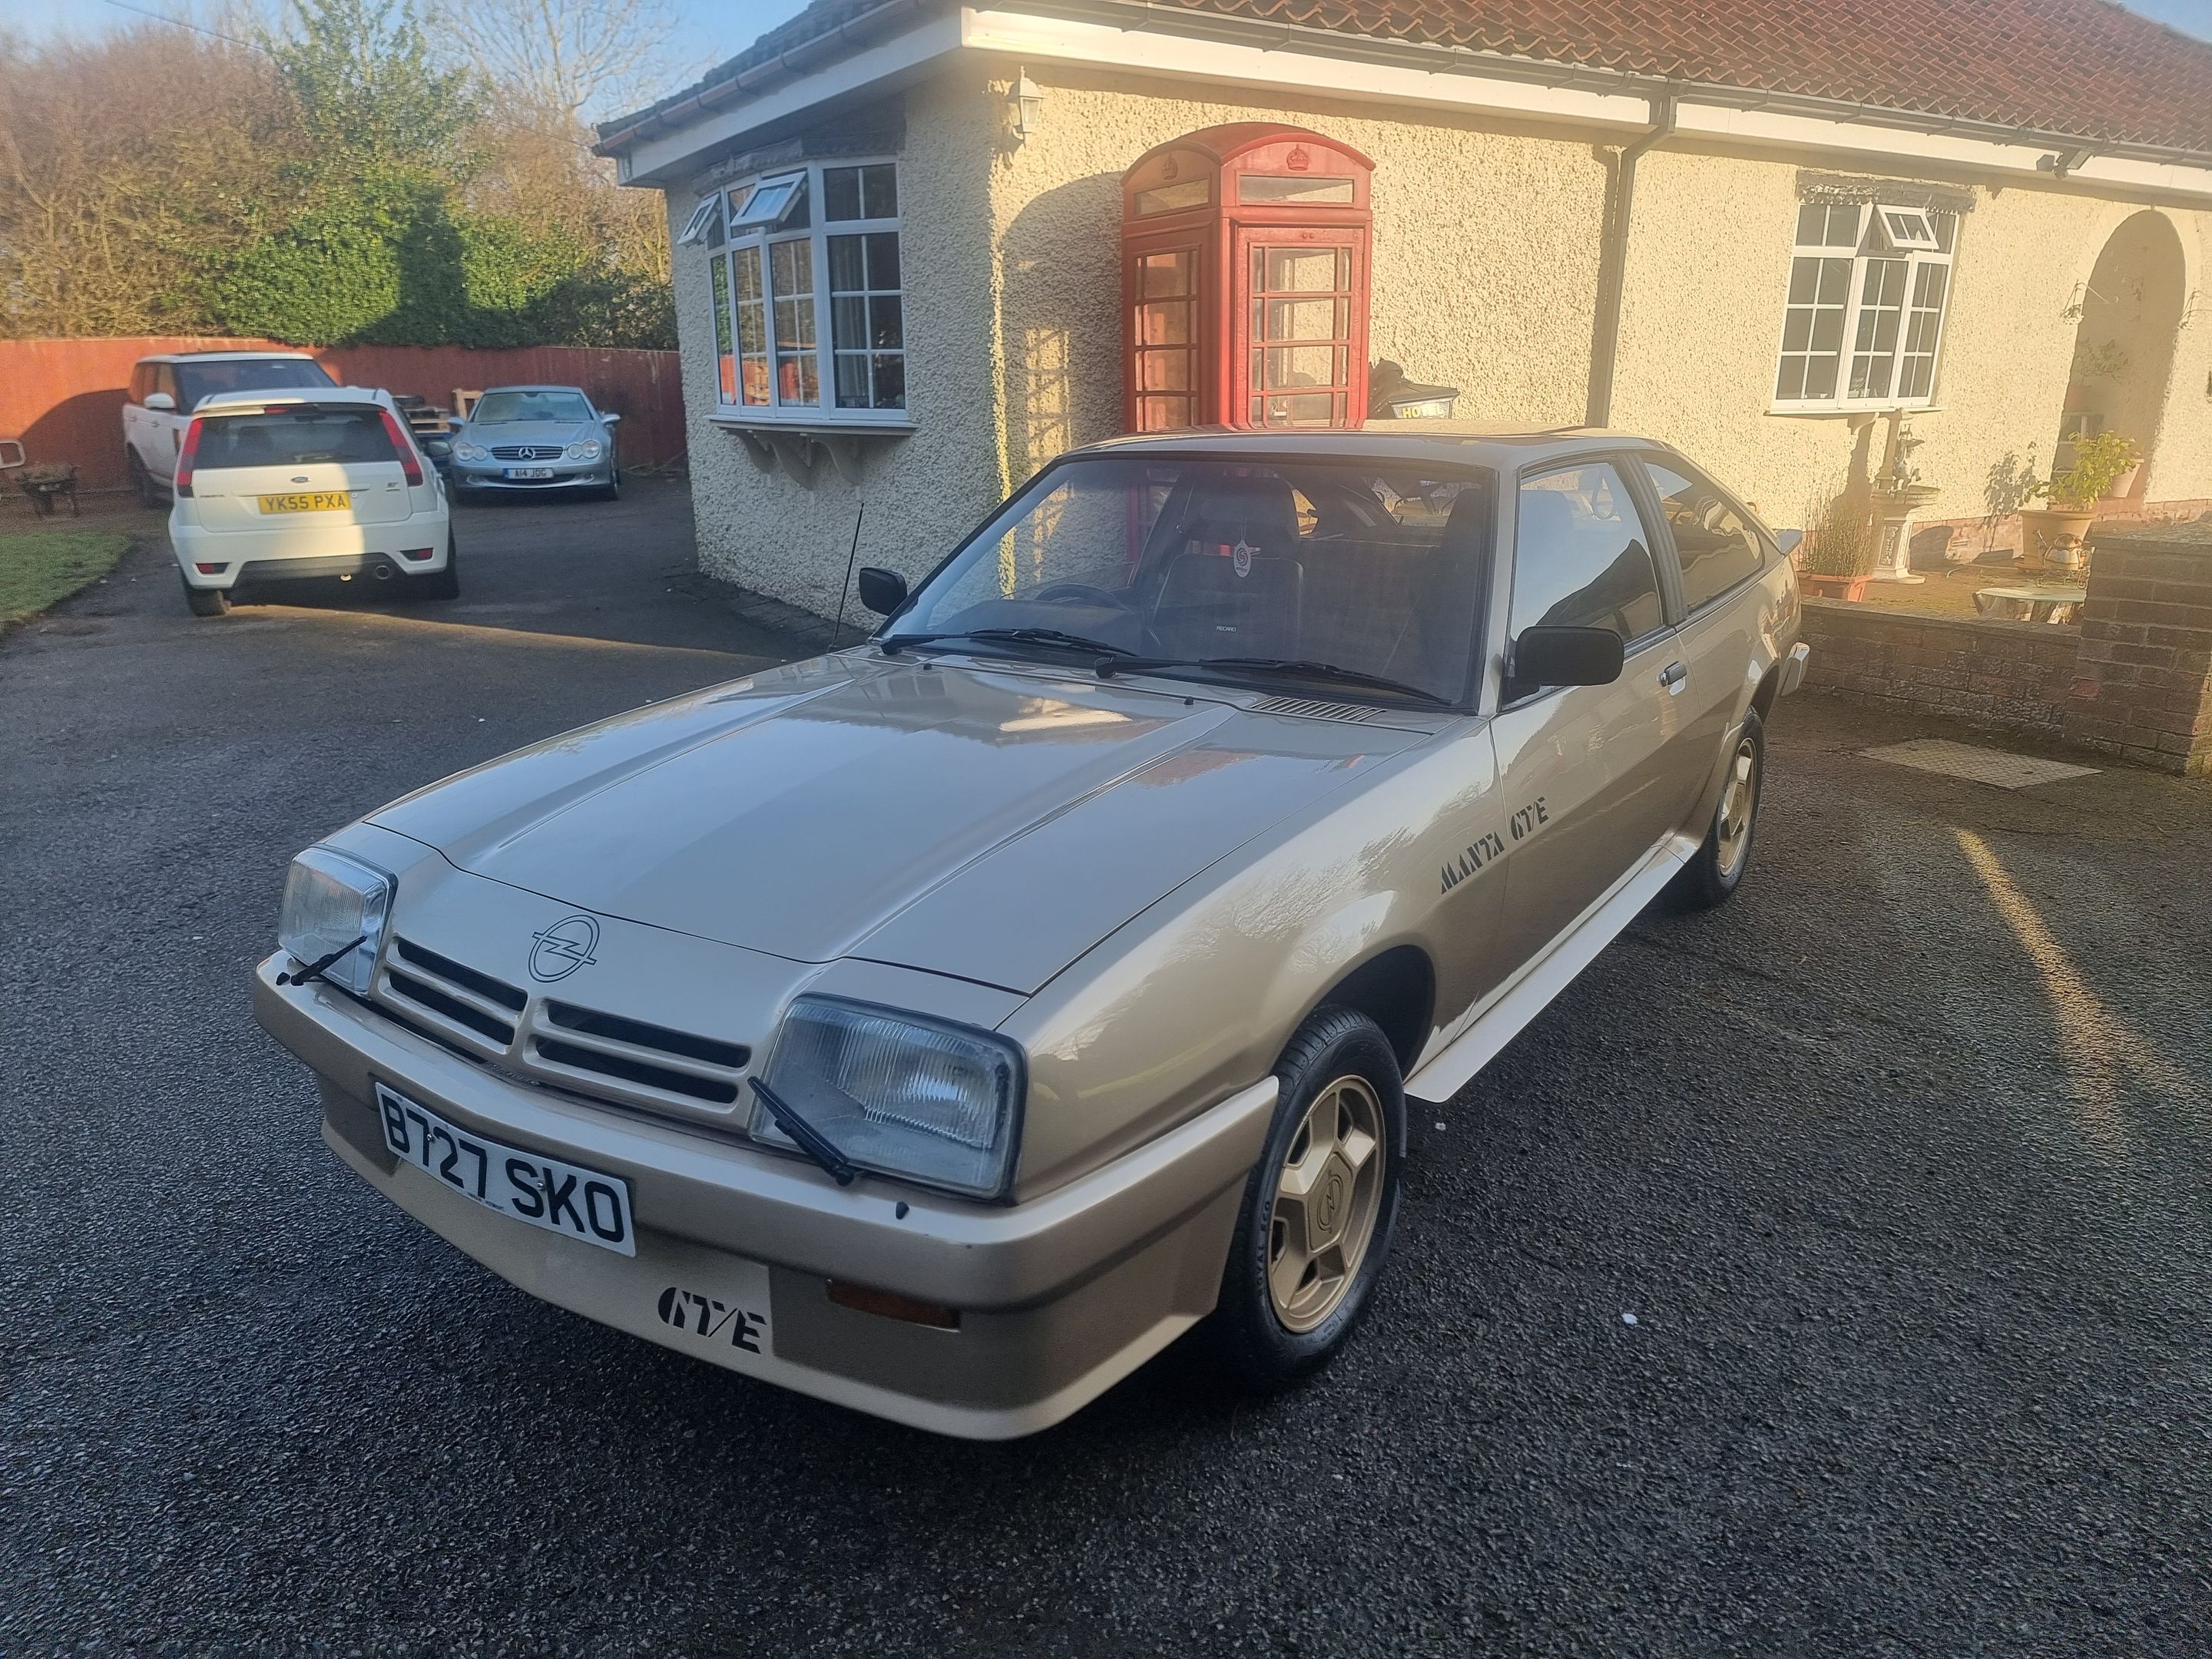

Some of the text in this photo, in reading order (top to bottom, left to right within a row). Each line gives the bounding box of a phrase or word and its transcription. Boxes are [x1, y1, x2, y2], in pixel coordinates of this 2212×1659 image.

[265, 494, 346, 511] YK55 PXA
[1441, 830, 1505, 895] MANTA
[381, 1093, 624, 1243] B727 SKO
